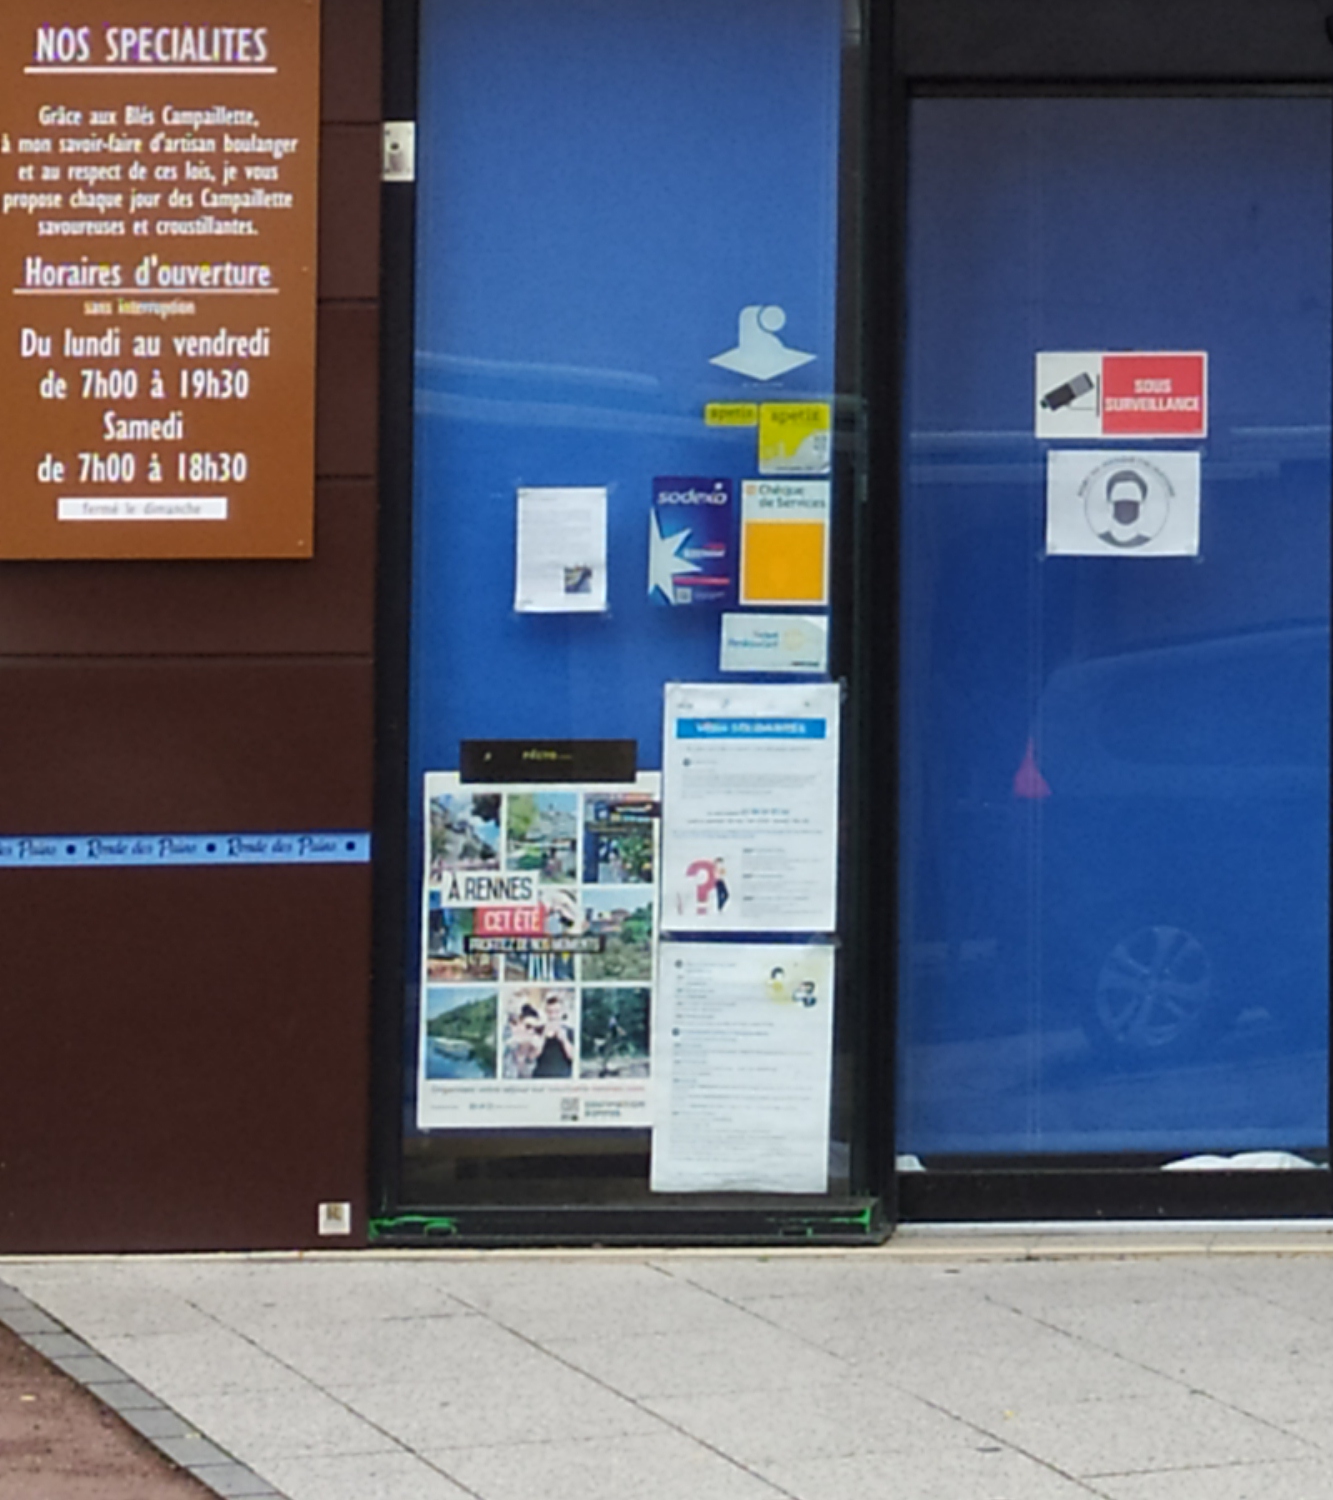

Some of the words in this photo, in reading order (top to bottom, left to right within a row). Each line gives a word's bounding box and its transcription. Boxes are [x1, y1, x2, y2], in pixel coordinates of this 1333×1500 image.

[36, 27, 91, 63] NOS
[106, 27, 267, 63] SPECIALITES
[39, 105, 81, 127] Grâce
[89, 109, 117, 126] aux
[125, 105, 155, 126] Blés
[162, 105, 259, 130] Campaillette,
[1, 133, 11, 153] à
[18, 137, 51, 153] mon
[59, 133, 142, 154] savoir-faire
[150, 133, 215, 154] d'artisan
[224, 134, 297, 158] boulanger
[18, 163, 33, 181] et
[42, 165, 60, 181] au
[68, 163, 121, 185] respect
[129, 161, 147, 181] de
[155, 165, 177, 181] ces
[186, 161, 216, 184] lois,
[223, 162, 237, 185] je
[245, 165, 279, 181] vous
[3, 192, 62, 213] propose
[70, 189, 123, 212] chaque
[130, 190, 160, 212] jour
[169, 189, 193, 209] des
[201, 189, 293, 213] Campaillette
[38, 220, 125, 237] savoureuses
[133, 219, 148, 237] et
[156, 217, 258, 237] croustillantes.
[25, 257, 121, 287] Horaires
[136, 256, 271, 287] d'ouverture
[85, 302, 112, 315] sans
[21, 329, 50, 357] Du
[64, 328, 120, 357] lundi
[133, 334, 160, 357] au
[173, 328, 269, 357] vendredi
[40, 371, 66, 399] de
[81, 370, 138, 400] 7h00
[151, 370, 164, 399] à
[180, 369, 249, 399] 19h30
[1134, 379, 1173, 393] SOUS
[1105, 397, 1200, 412] SURVEILLANCE
[104, 411, 184, 441] Samedi
[38, 454, 63, 483] de
[78, 453, 135, 483] 7h00
[148, 453, 162, 483] à
[178, 453, 247, 483] 18h30
[656, 482, 727, 506] sodexo
[81, 501, 118, 516] fermé
[144, 500, 201, 516] dimanche
[464, 876, 532, 901] RENNES
[483, 910, 512, 932] CET
[515, 905, 541, 932] ÉTÉ
